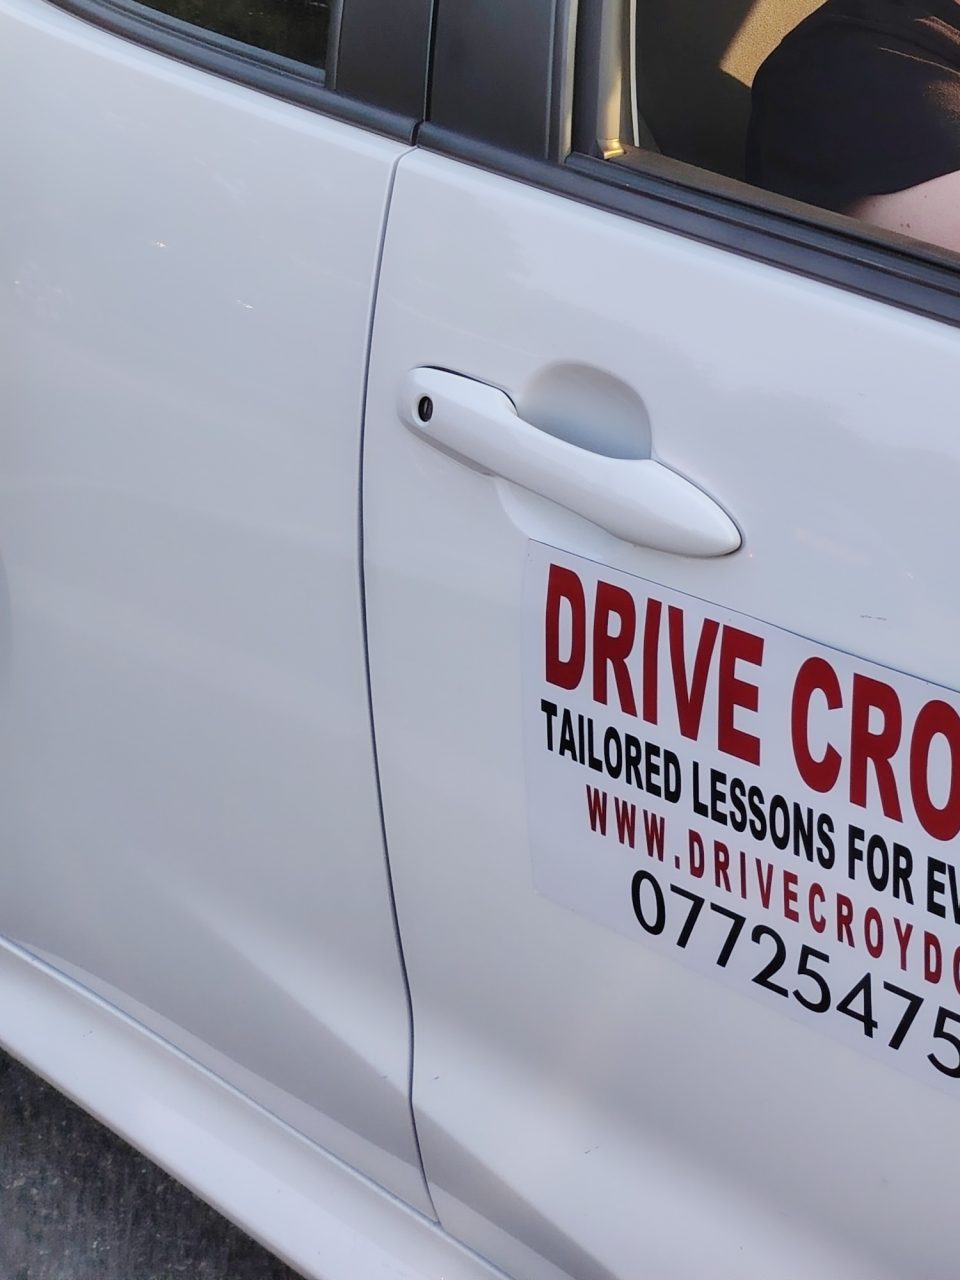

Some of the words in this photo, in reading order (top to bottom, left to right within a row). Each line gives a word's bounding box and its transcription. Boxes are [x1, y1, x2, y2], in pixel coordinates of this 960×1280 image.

[544, 563, 764, 766] DRIVE
[540, 699, 681, 803] TAILORED
[692, 762, 835, 869] LESSONS
[847, 828, 913, 904] FOR
